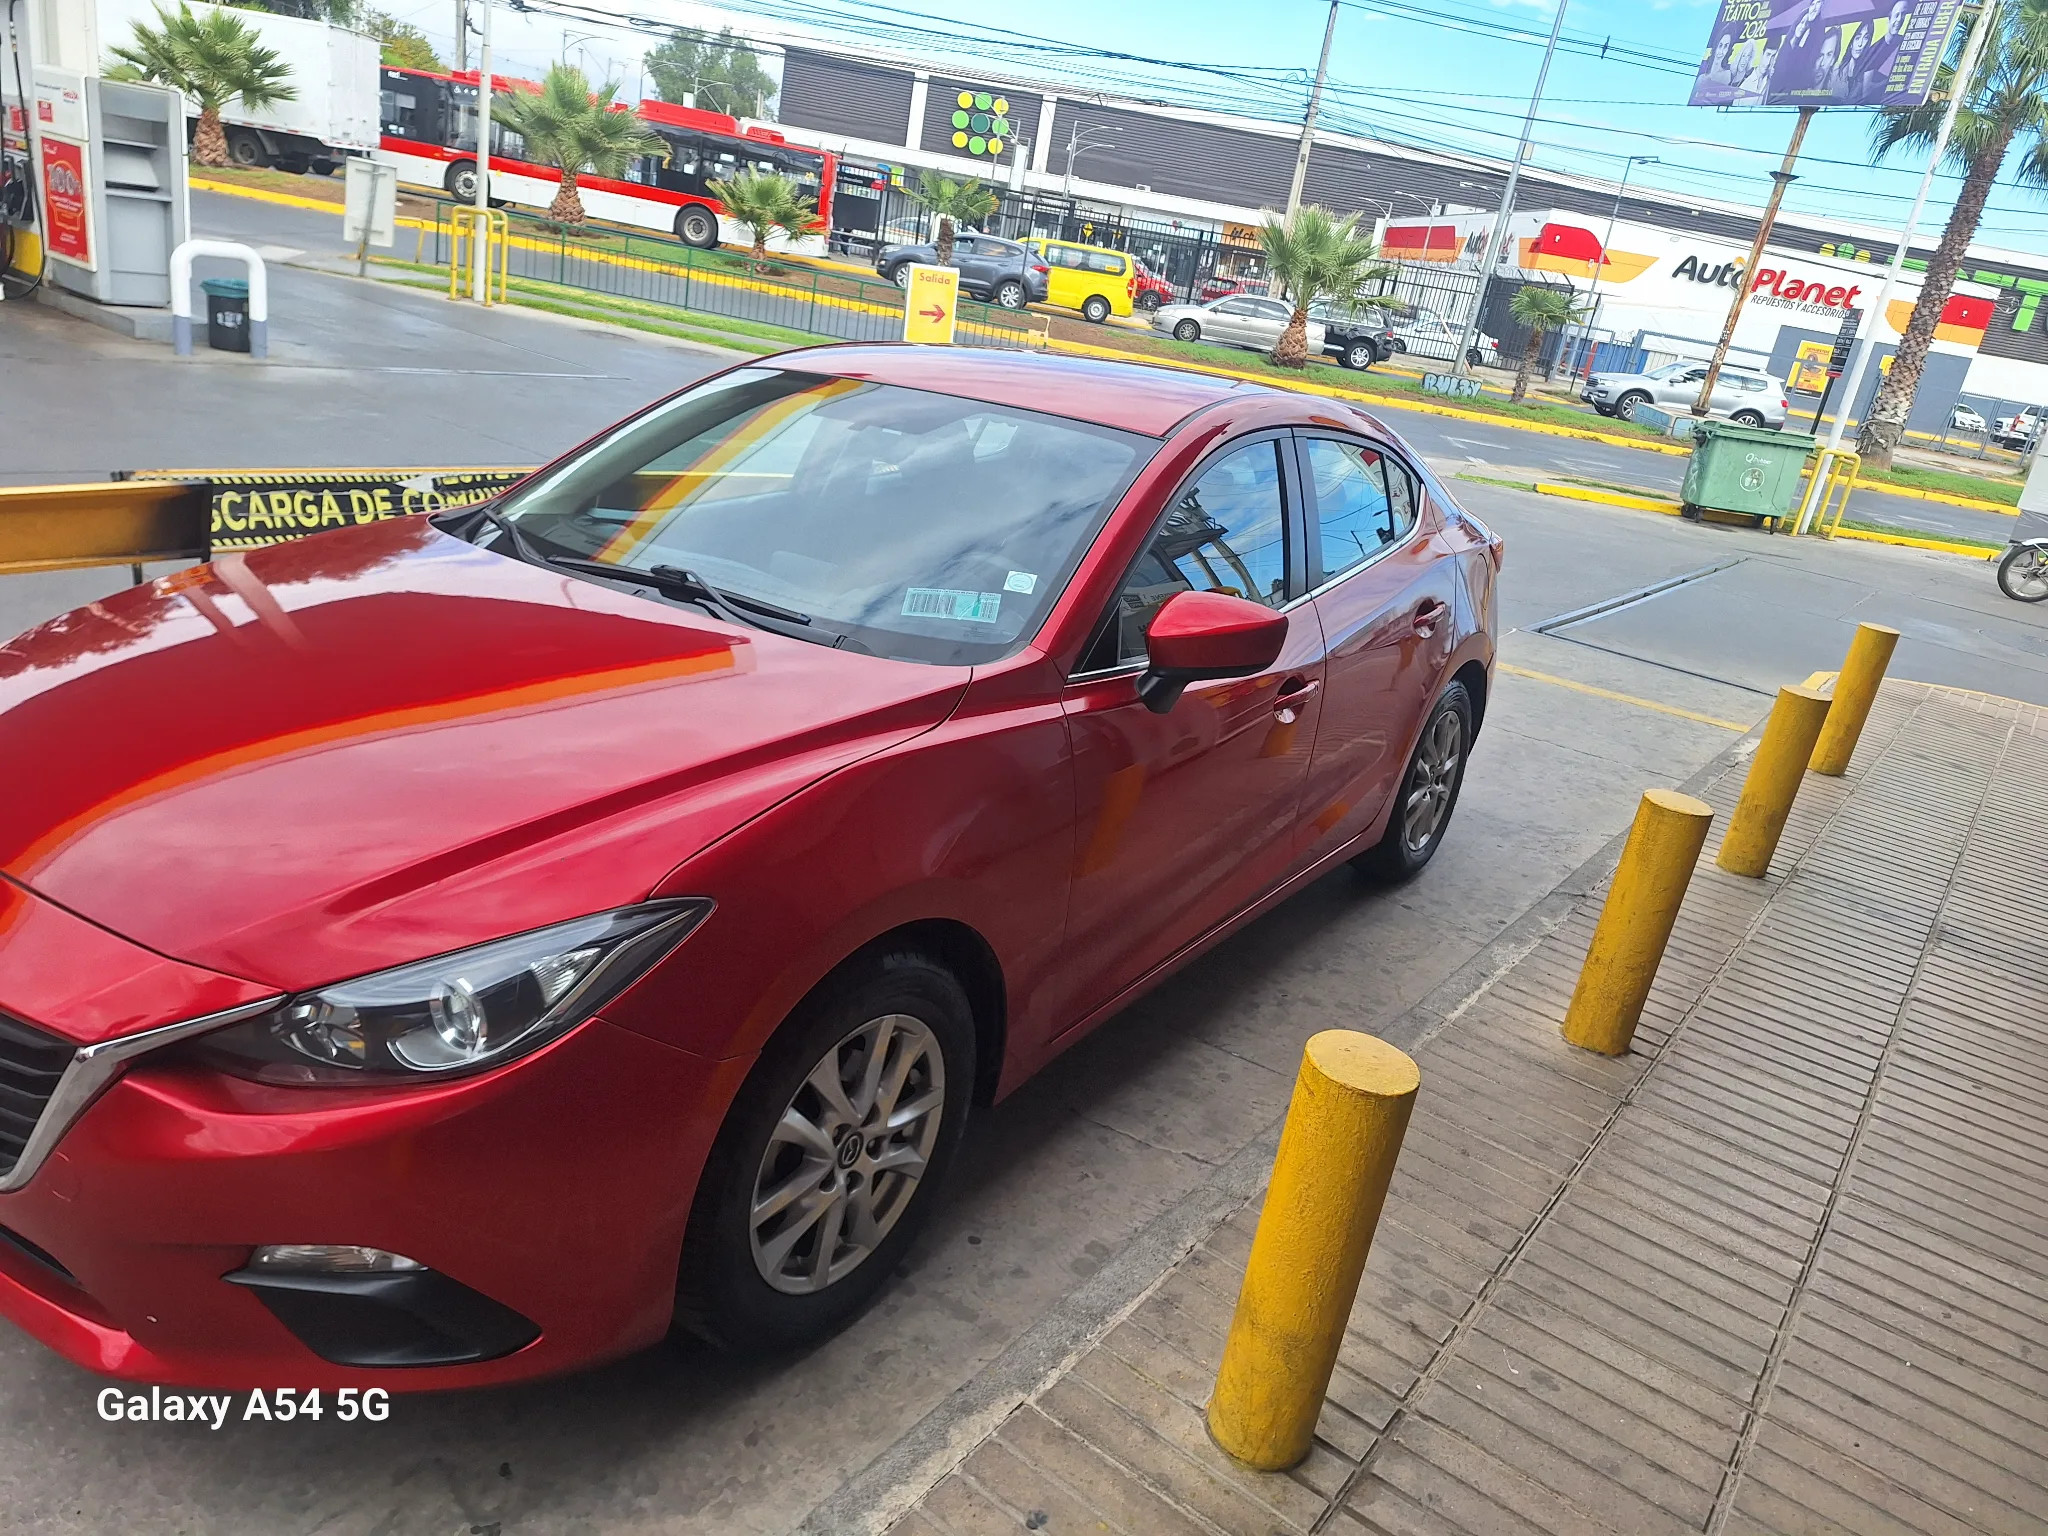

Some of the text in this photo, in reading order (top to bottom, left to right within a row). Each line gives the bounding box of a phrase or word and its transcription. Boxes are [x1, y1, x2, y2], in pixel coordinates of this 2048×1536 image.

[1722, 2, 1761, 22] TEATRO
[1739, 20, 1768, 39] 2026
[1908, 39, 1941, 93] ENTRADA
[919, 272, 951, 285] Salida
[1750, 294, 1796, 310] REPUESTOS
[1795, 302, 1802, 312] Y
[350, 488, 397, 525] DE
